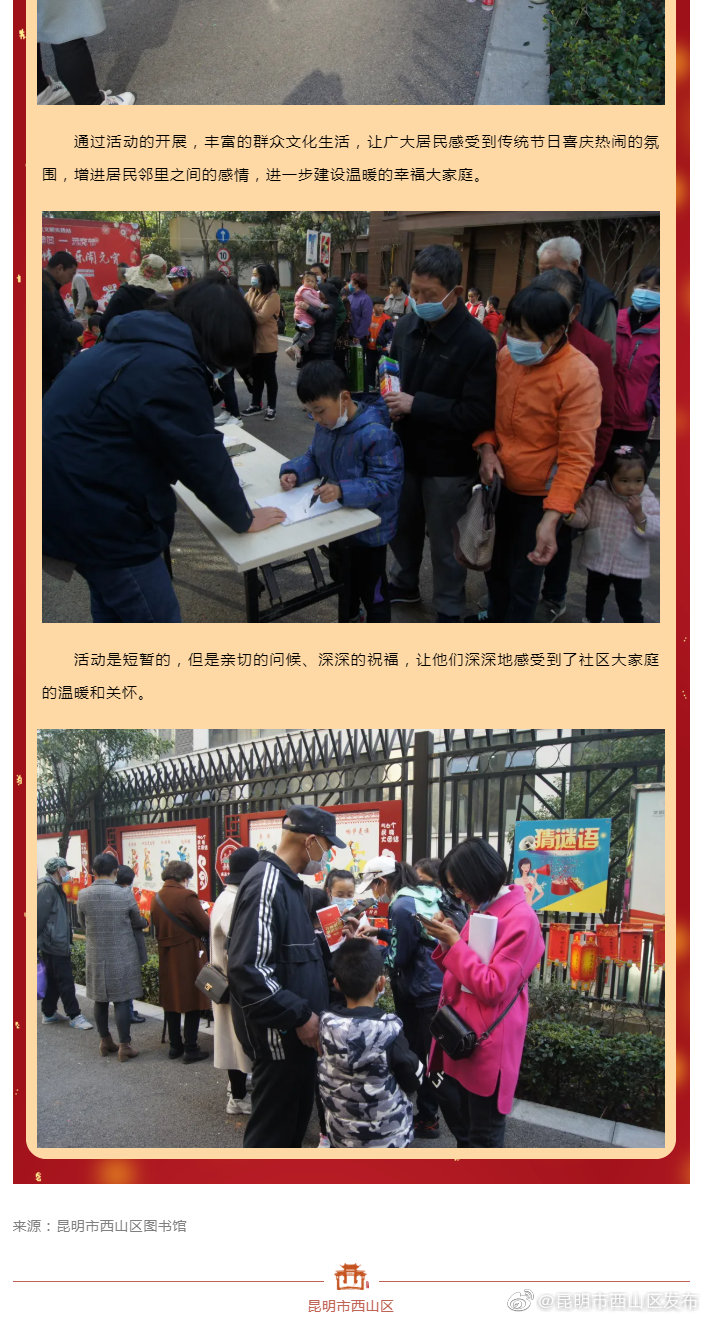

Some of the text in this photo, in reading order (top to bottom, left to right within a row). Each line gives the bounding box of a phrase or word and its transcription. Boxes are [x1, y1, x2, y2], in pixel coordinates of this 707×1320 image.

[73, 134, 660, 150] 通过活动的开展，丰富的群众文化生活，让广大居民感受到传统节日喜庆热闹的氛
[42, 167, 481, 183] 围，增进居民邻里之间的感情，进一步建设温暖的幸福大家庭。
[65, 248, 120, 266] 乐闹元宵
[219, 251, 228, 260] 10
[73, 652, 660, 668] 活动是短暂的，但是亲切的问候、深深的祝福，让他们深深地感受到了社区大家庭
[42, 685, 146, 701] 的温暖和关怀。
[534, 827, 600, 851] 猜谜语
[12, 1219, 188, 1233] 来源：昆明市西山区图书馆
[307, 1299, 395, 1313] 昆明市西山区
